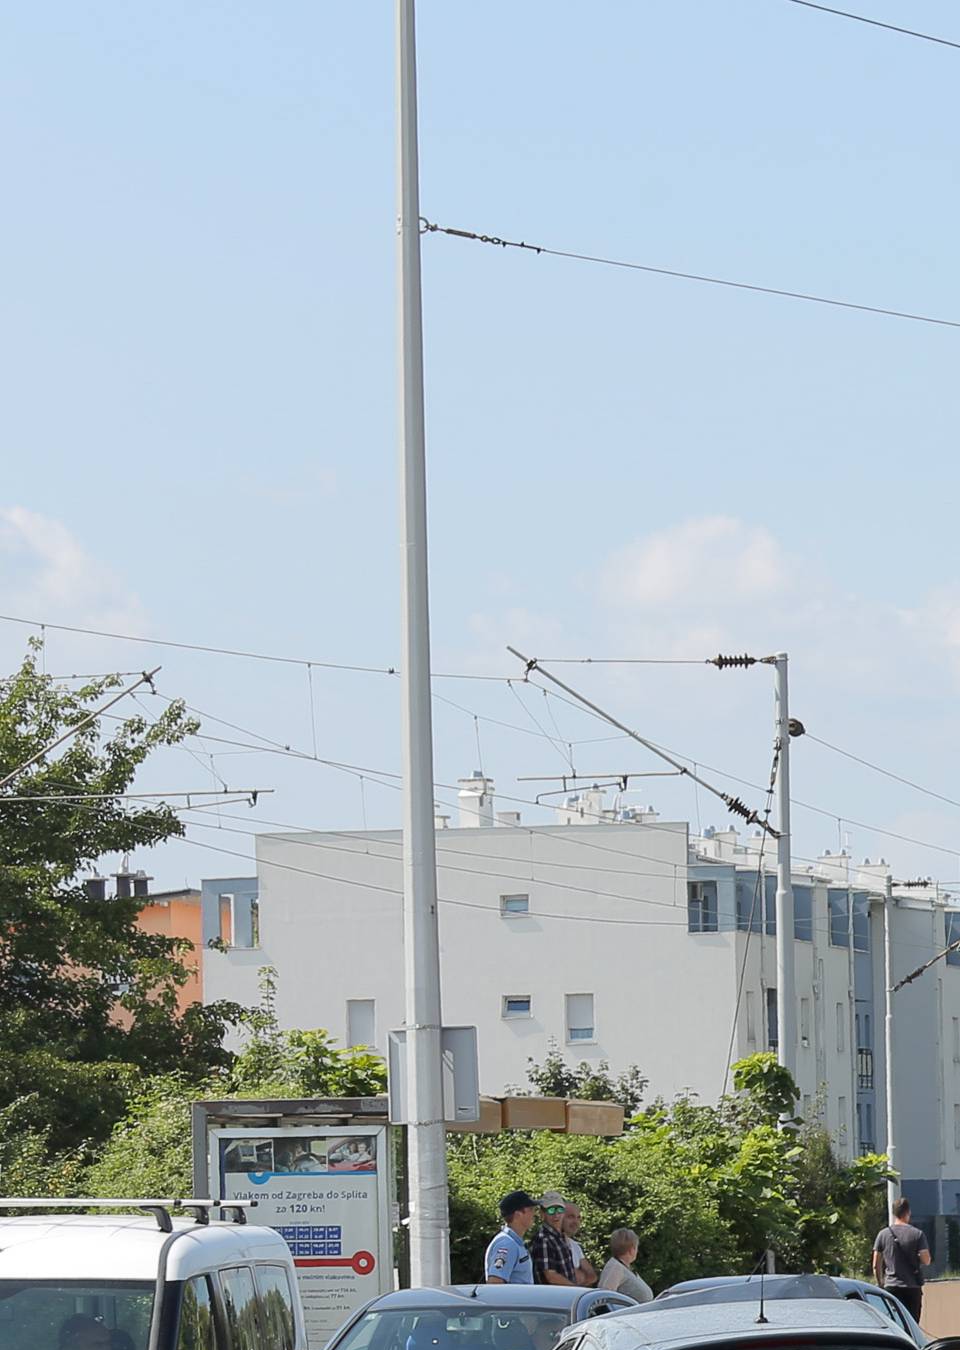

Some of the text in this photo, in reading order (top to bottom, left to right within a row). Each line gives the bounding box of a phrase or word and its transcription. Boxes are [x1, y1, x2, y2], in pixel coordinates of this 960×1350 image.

[233, 1189, 368, 1202] Vlakom od Zagreba do Splita
[275, 1203, 326, 1214] za 120 kn!
